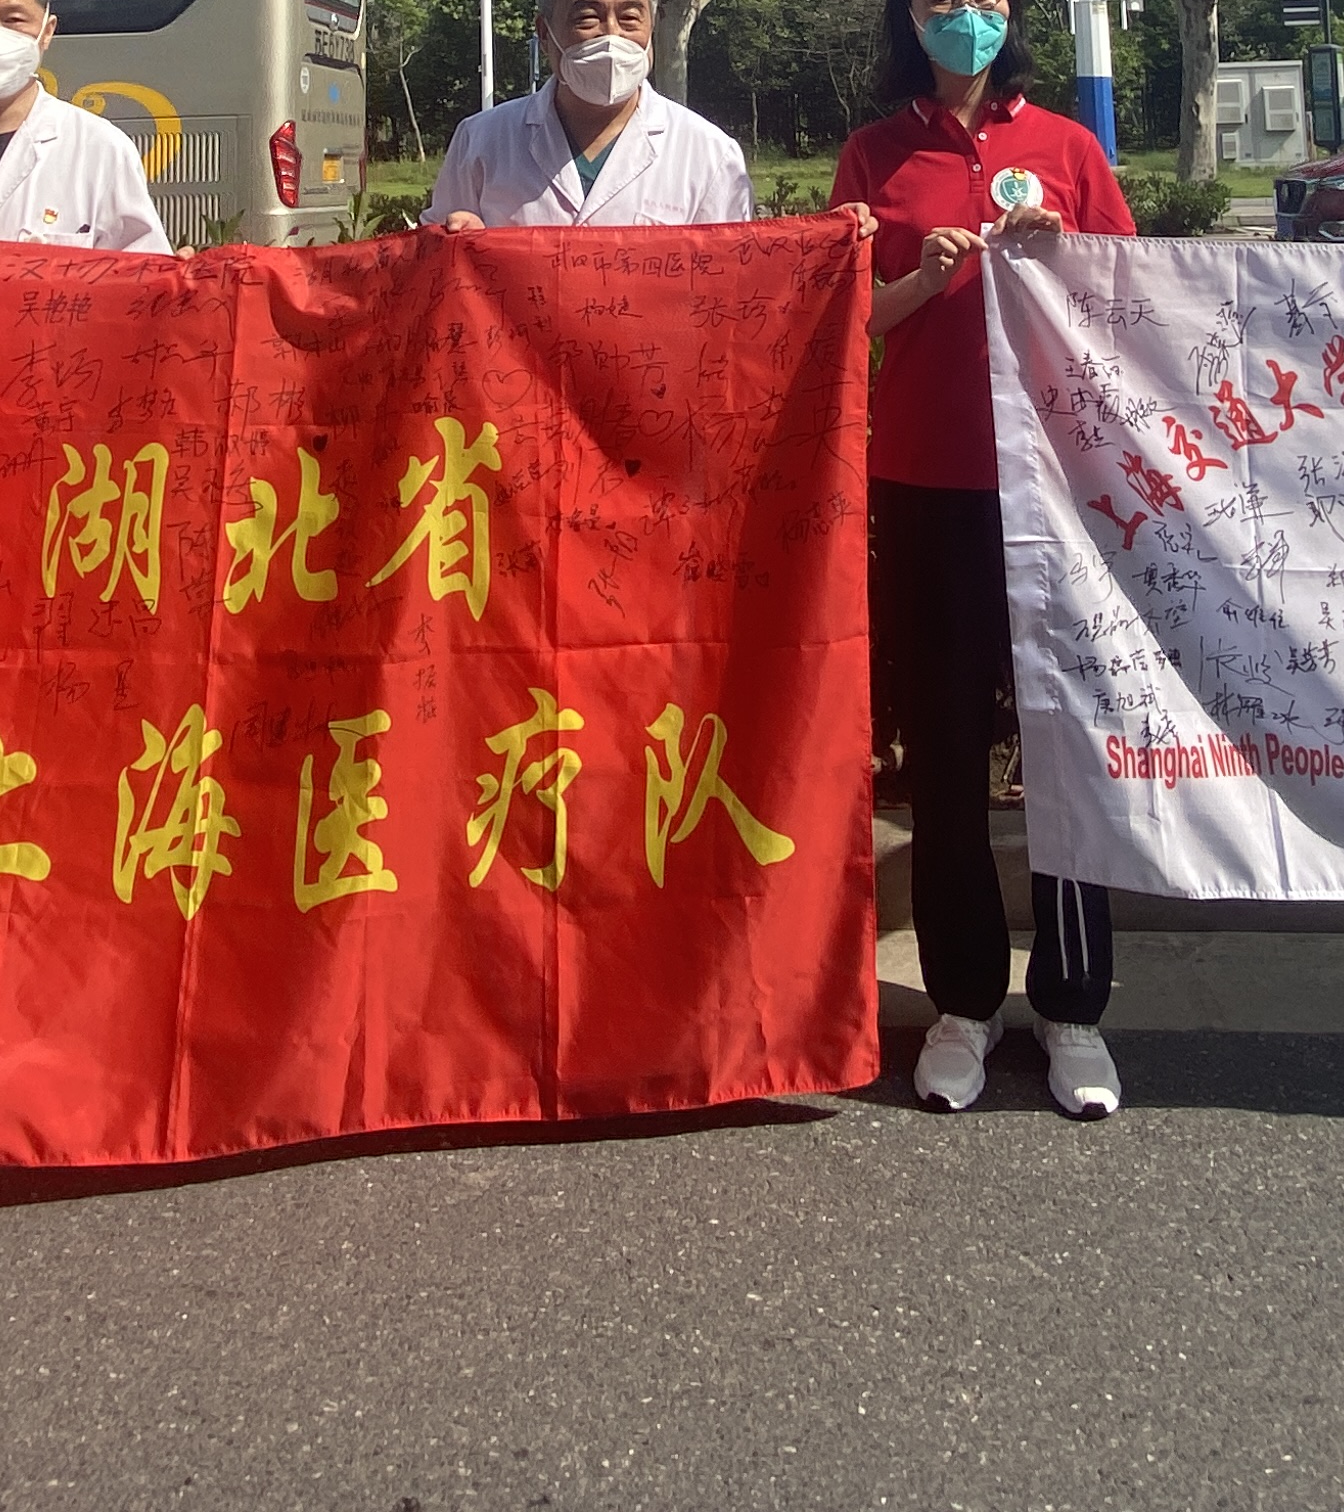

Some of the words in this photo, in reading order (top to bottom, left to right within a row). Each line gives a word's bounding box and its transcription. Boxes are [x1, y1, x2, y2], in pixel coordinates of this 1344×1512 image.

[1066, 292, 1170, 330] 陈云天
[43, 418, 502, 621] 湖北省
[1107, 734, 1207, 788] Shanghai
[1209, 733, 1261, 775] Ninth
